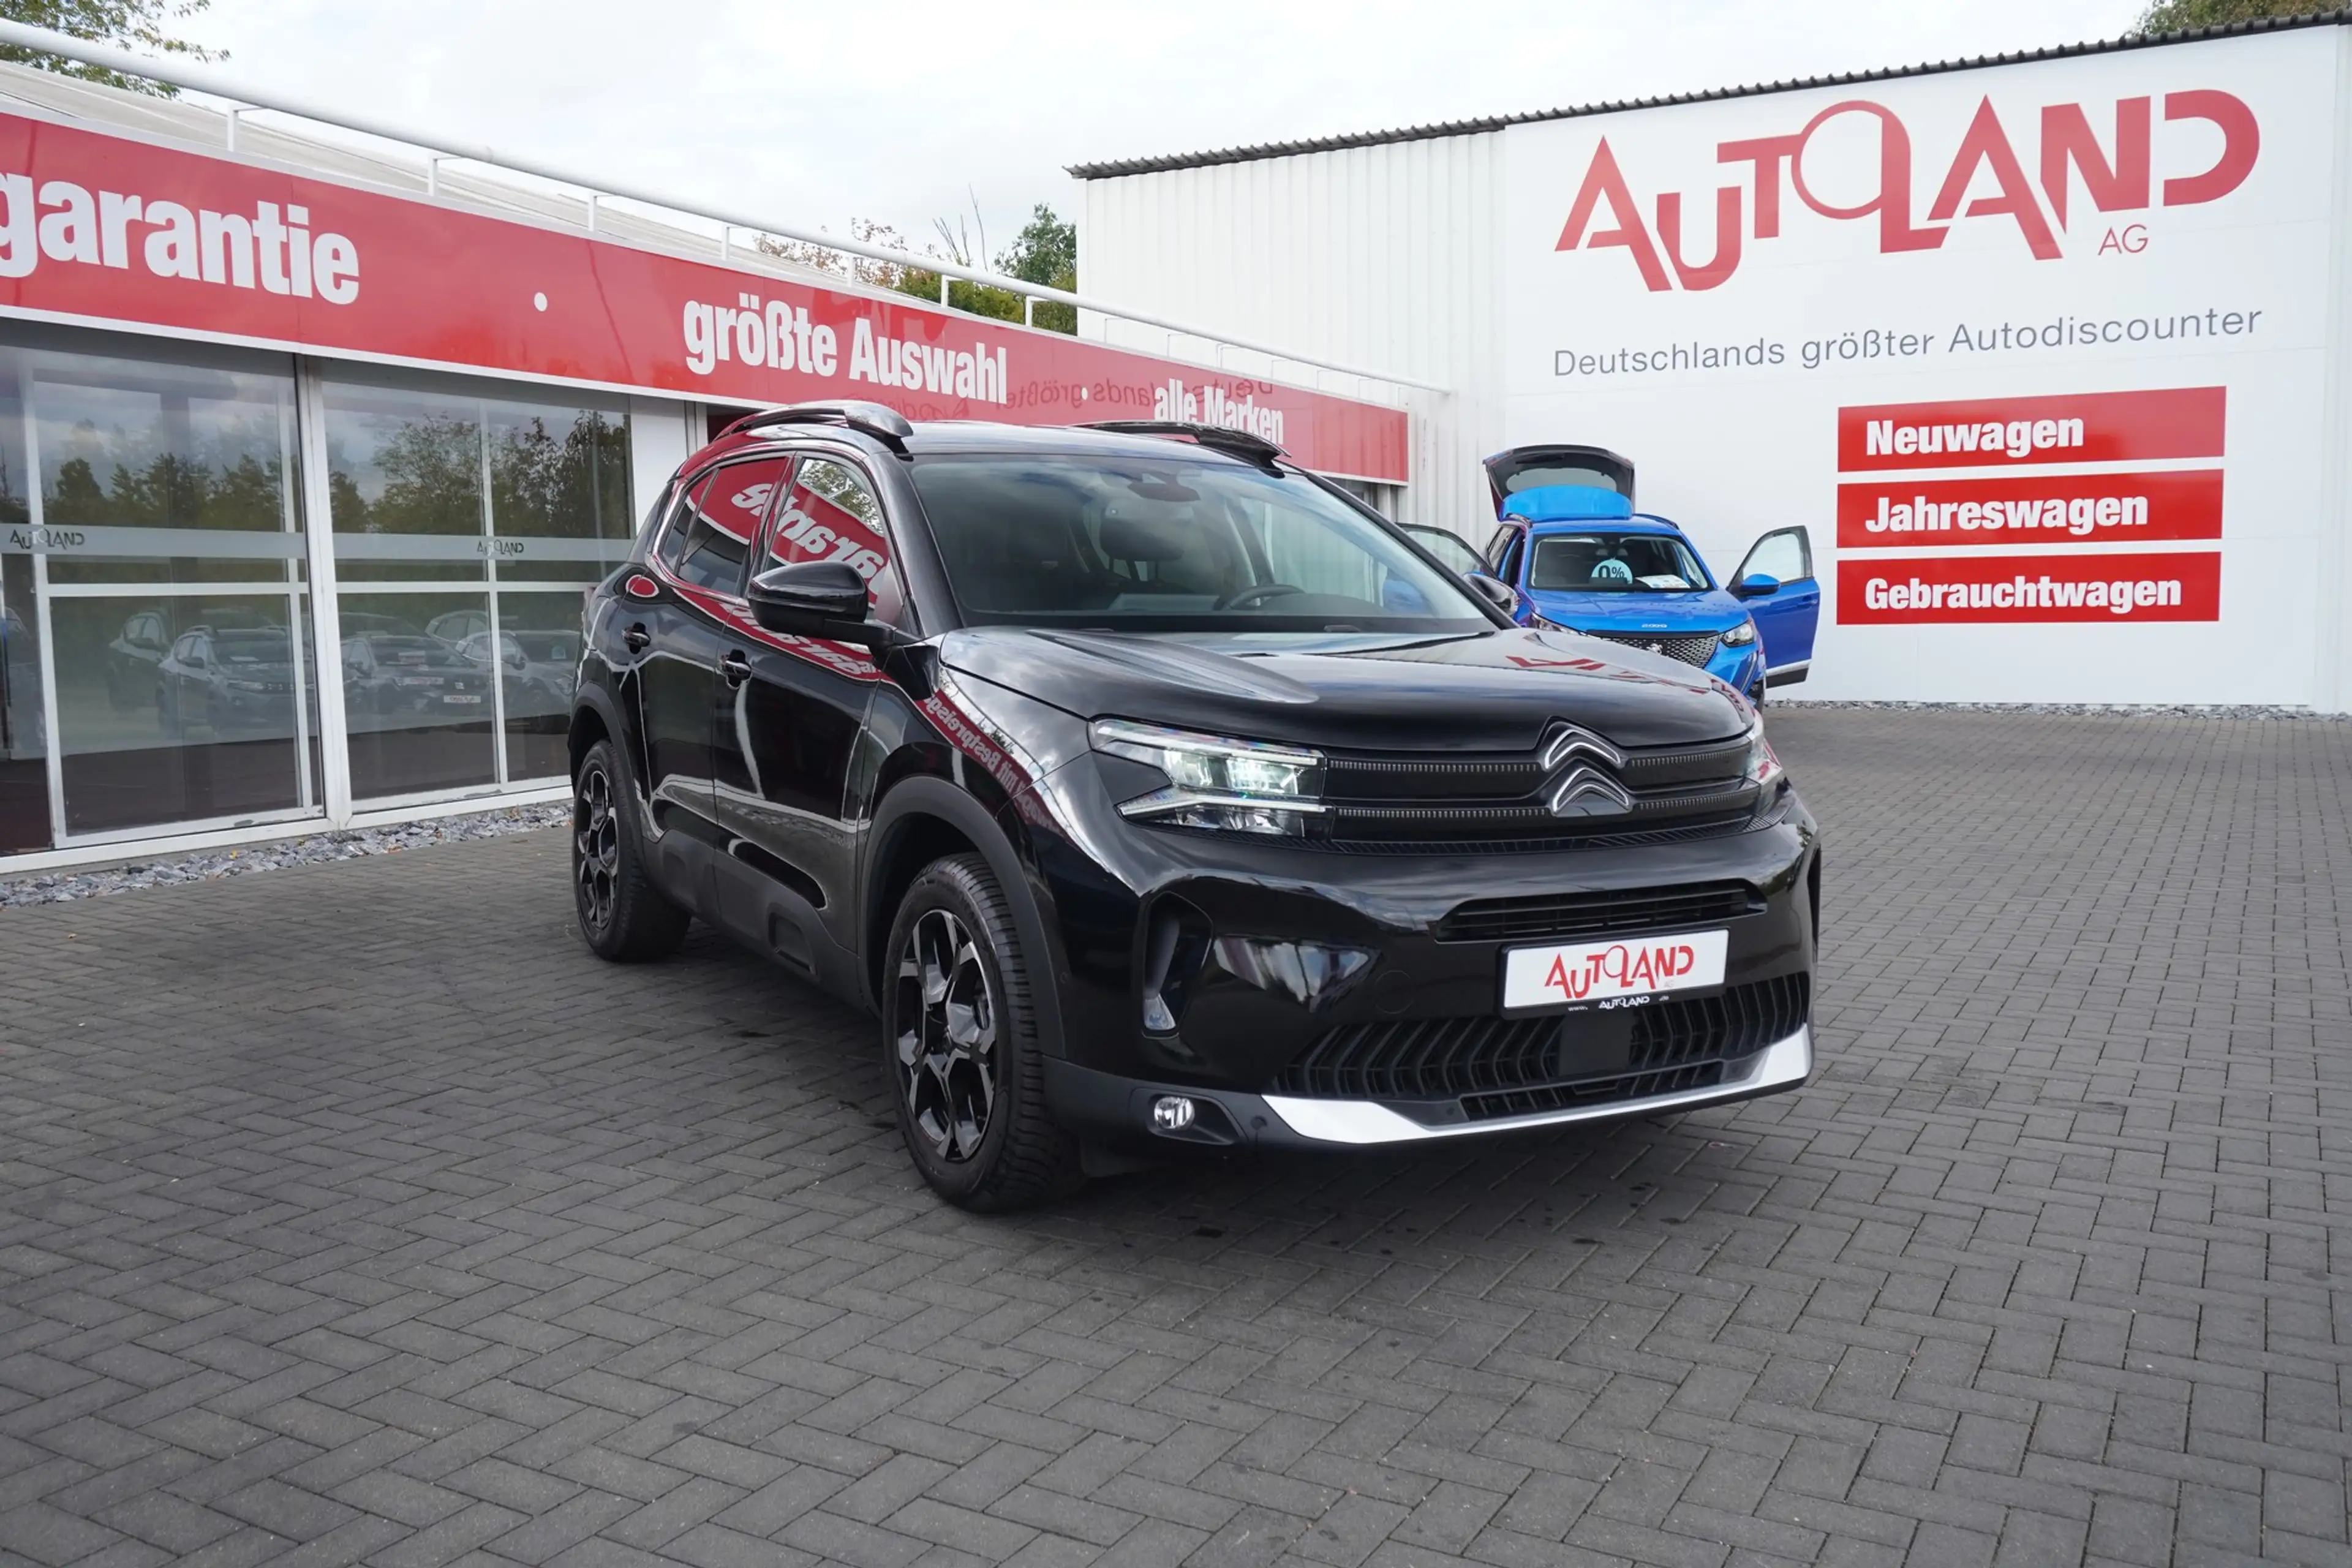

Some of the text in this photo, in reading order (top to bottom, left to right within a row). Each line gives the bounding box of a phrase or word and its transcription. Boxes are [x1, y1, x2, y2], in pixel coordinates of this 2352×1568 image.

[1554, 89, 2260, 292] AUTOLAND
[2098, 224, 2149, 255] AG
[684, 292, 1007, 404] größte Auswahl
[1555, 308, 2261, 376] Deutschlands größter Autodiscounter
[1155, 379, 1284, 445] alle Marken
[1866, 418, 2084, 458] Neuwagen
[1865, 496, 2148, 535] Jahreswagen
[1865, 576, 2181, 614] Gebrauchtwagen
[1544, 945, 1694, 999] AUTOLAND
